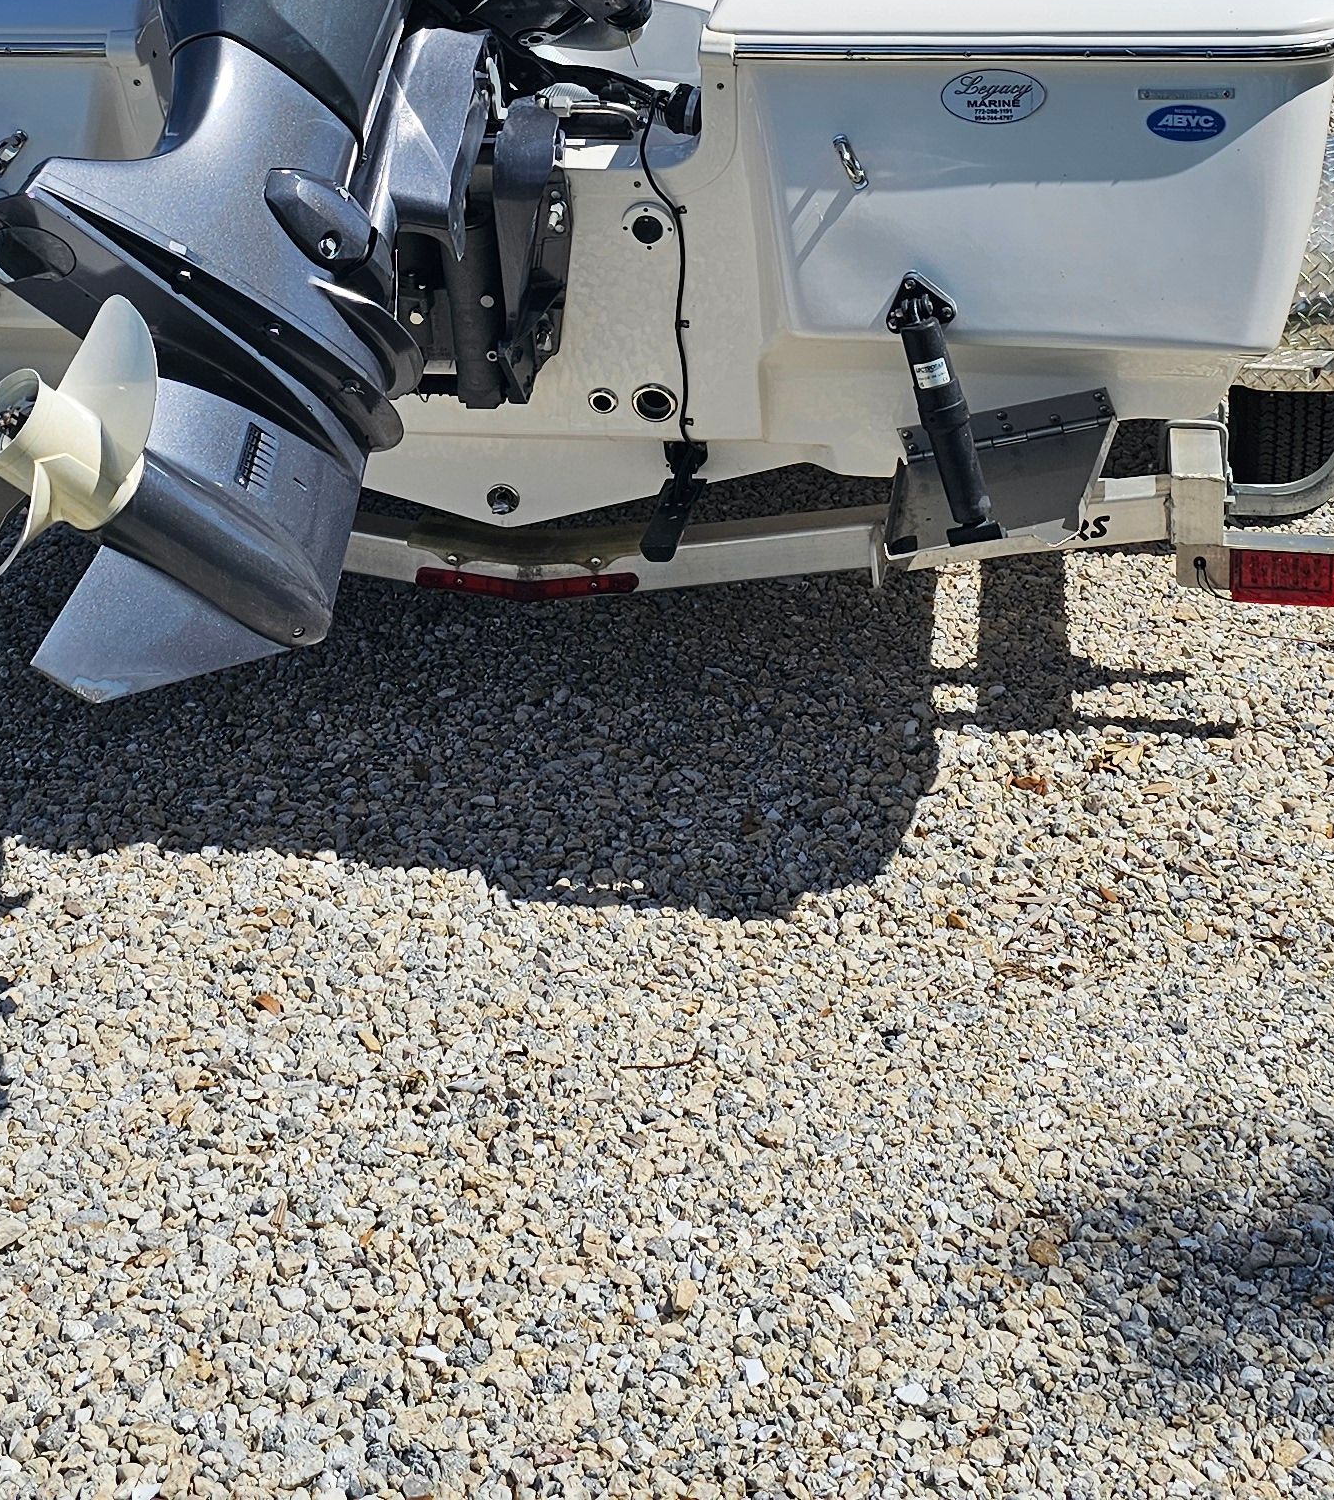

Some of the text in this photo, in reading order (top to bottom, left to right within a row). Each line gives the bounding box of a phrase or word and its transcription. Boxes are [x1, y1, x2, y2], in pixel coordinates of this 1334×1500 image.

[954, 75, 1034, 100] Legacy
[966, 99, 1021, 108] MARINE
[1157, 114, 1215, 127] ABYC
